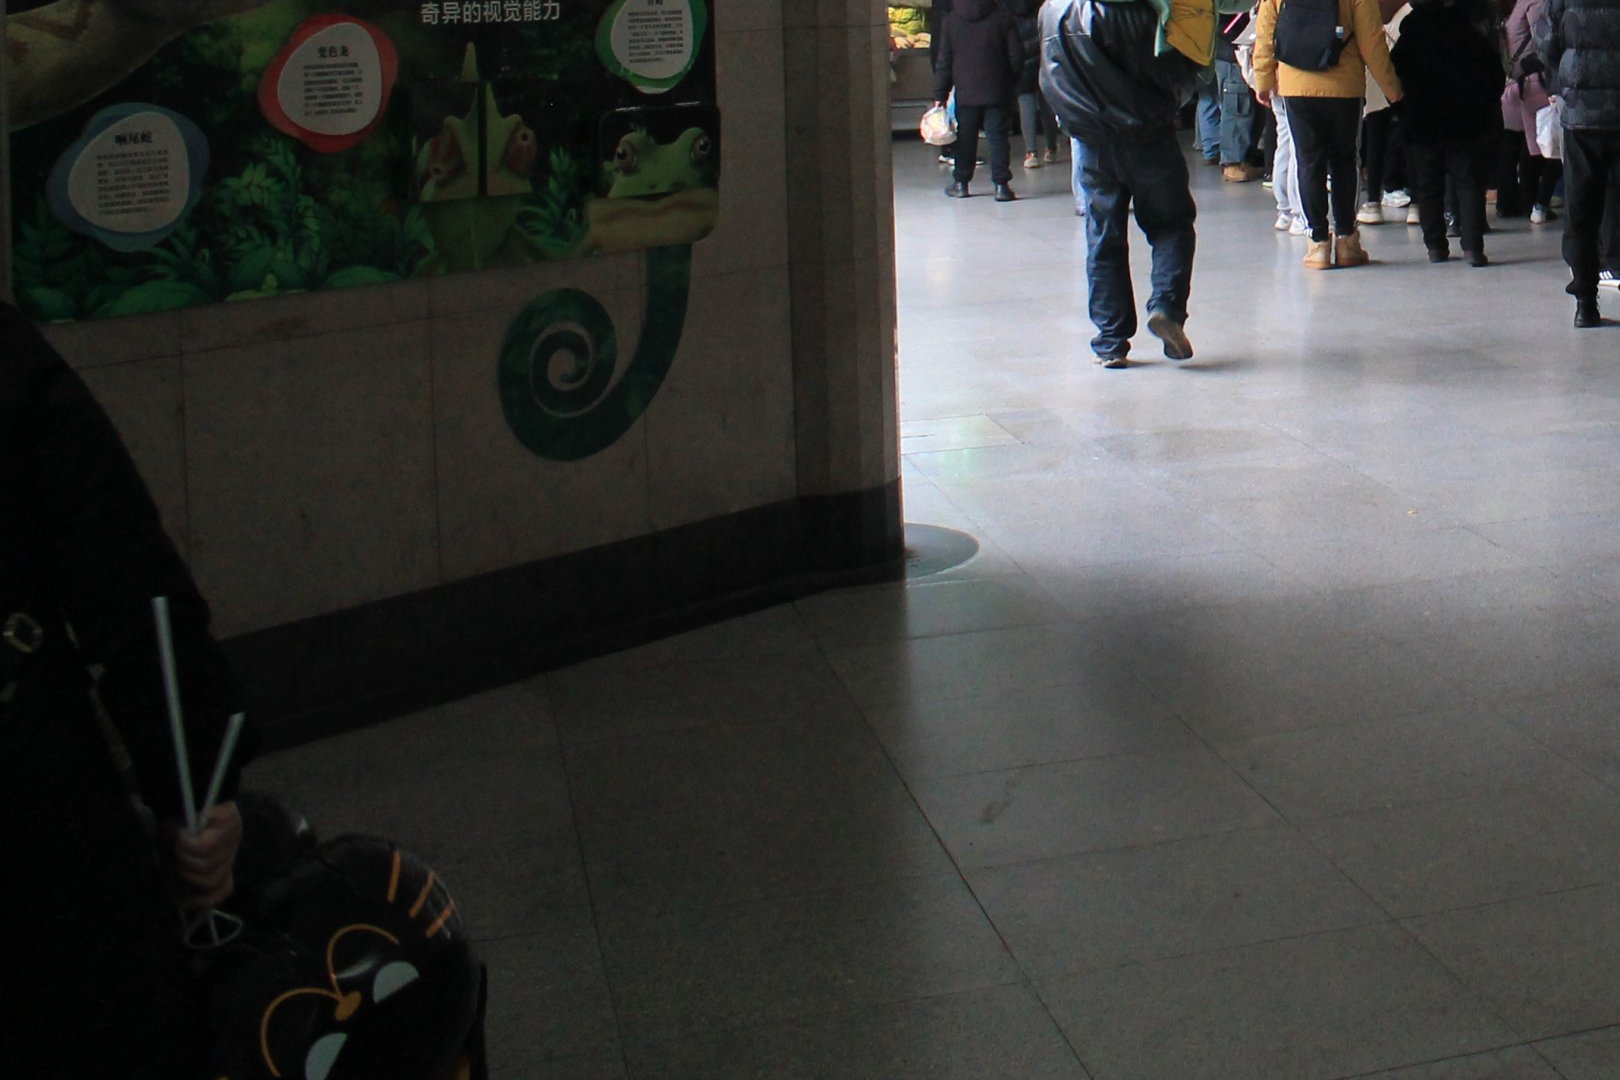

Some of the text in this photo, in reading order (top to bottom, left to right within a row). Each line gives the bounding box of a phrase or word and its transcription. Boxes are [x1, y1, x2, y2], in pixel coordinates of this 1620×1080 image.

[420, 0, 561, 25] 奇异的视觉能力
